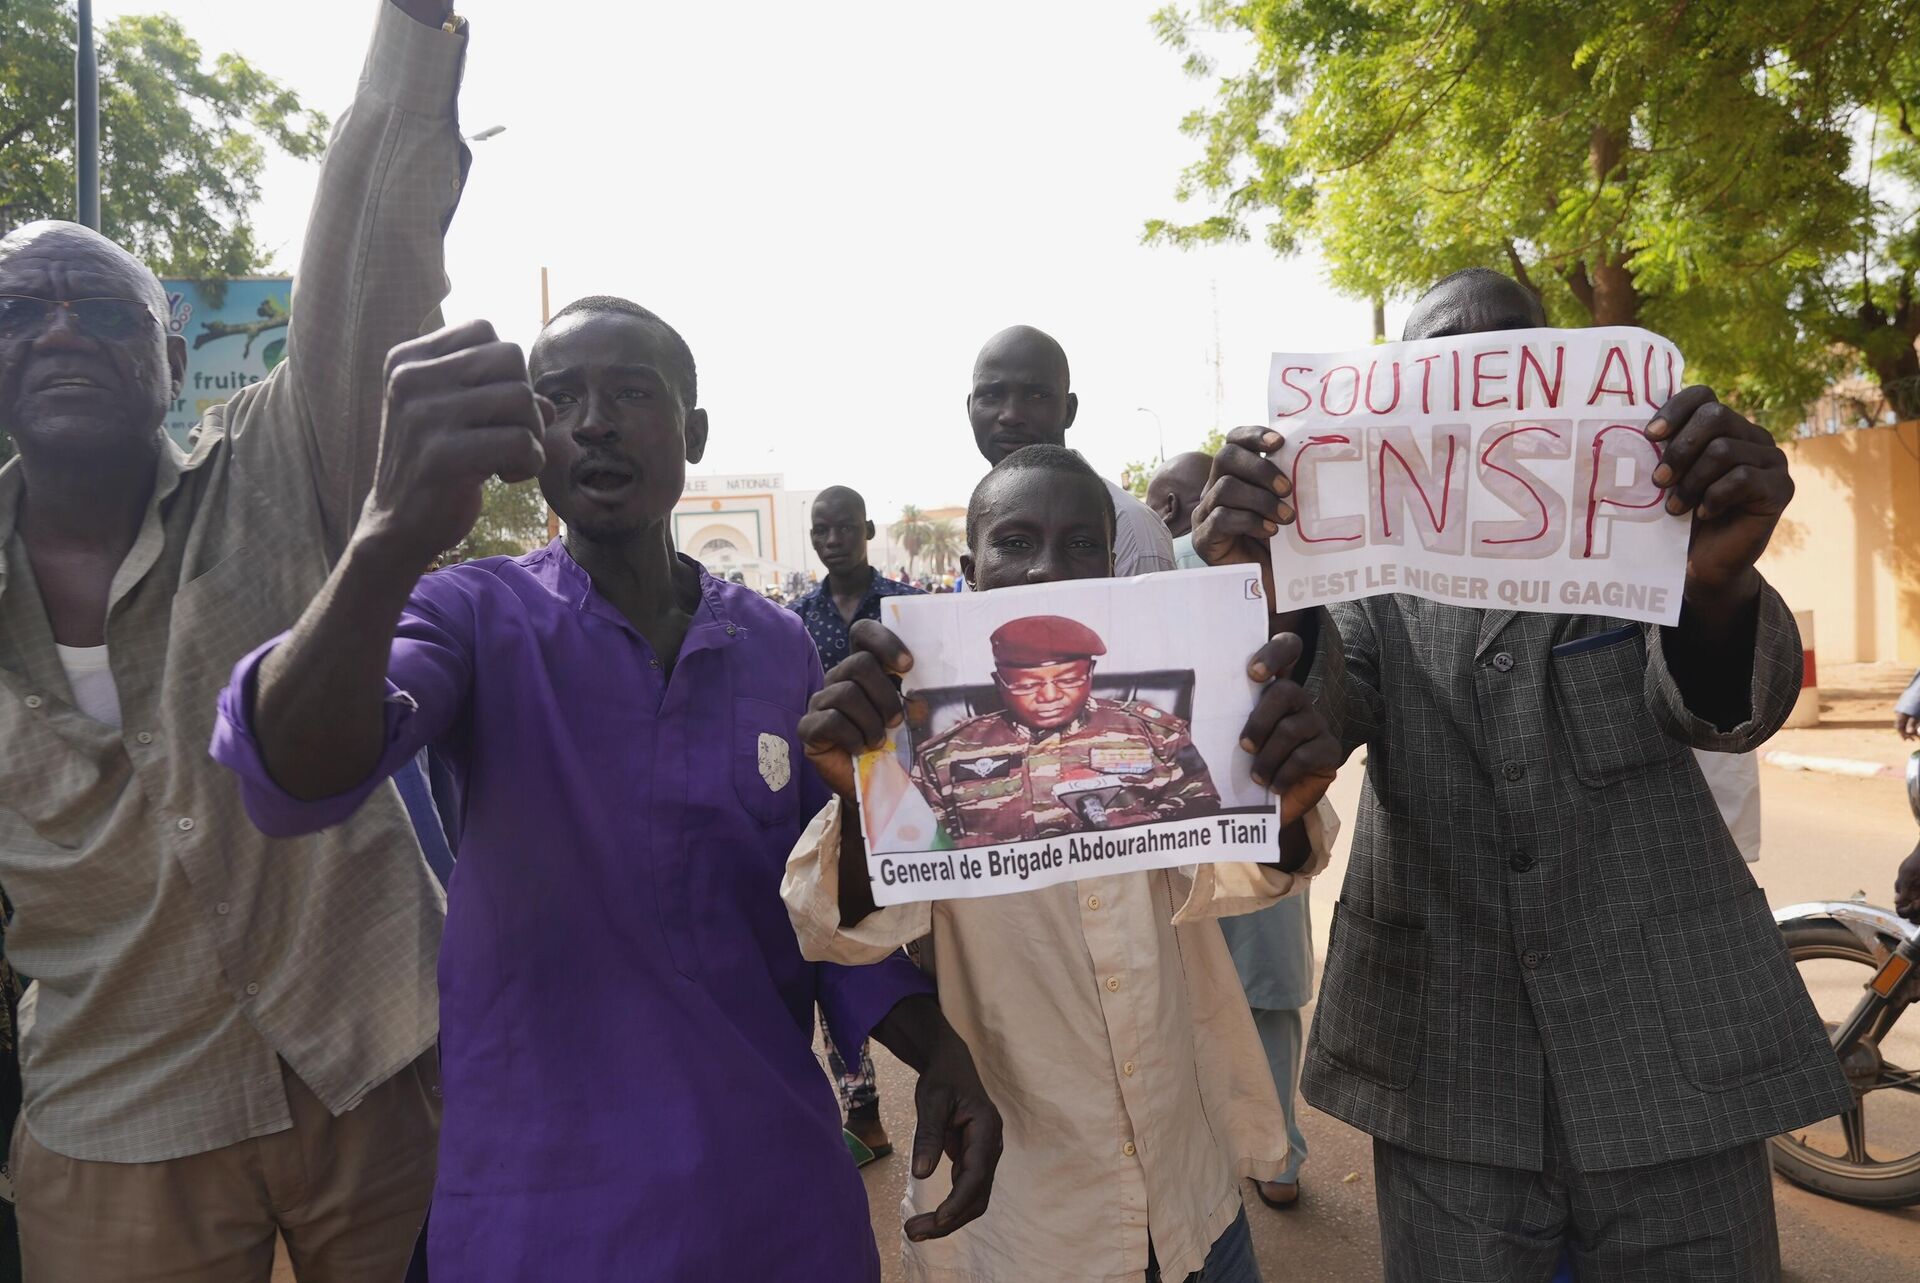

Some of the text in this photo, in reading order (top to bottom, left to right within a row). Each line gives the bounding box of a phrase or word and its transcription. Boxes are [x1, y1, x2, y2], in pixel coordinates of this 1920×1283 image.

[1276, 342, 1674, 417] SOUTIEN AU
[726, 477, 781, 490] NATIONALE
[1287, 419, 1667, 559] CNSP
[1287, 563, 1669, 613] C'EST LE NIGER QUI GAGNE
[880, 817, 1267, 886] General de Brigade Abdourahmane Tiani
